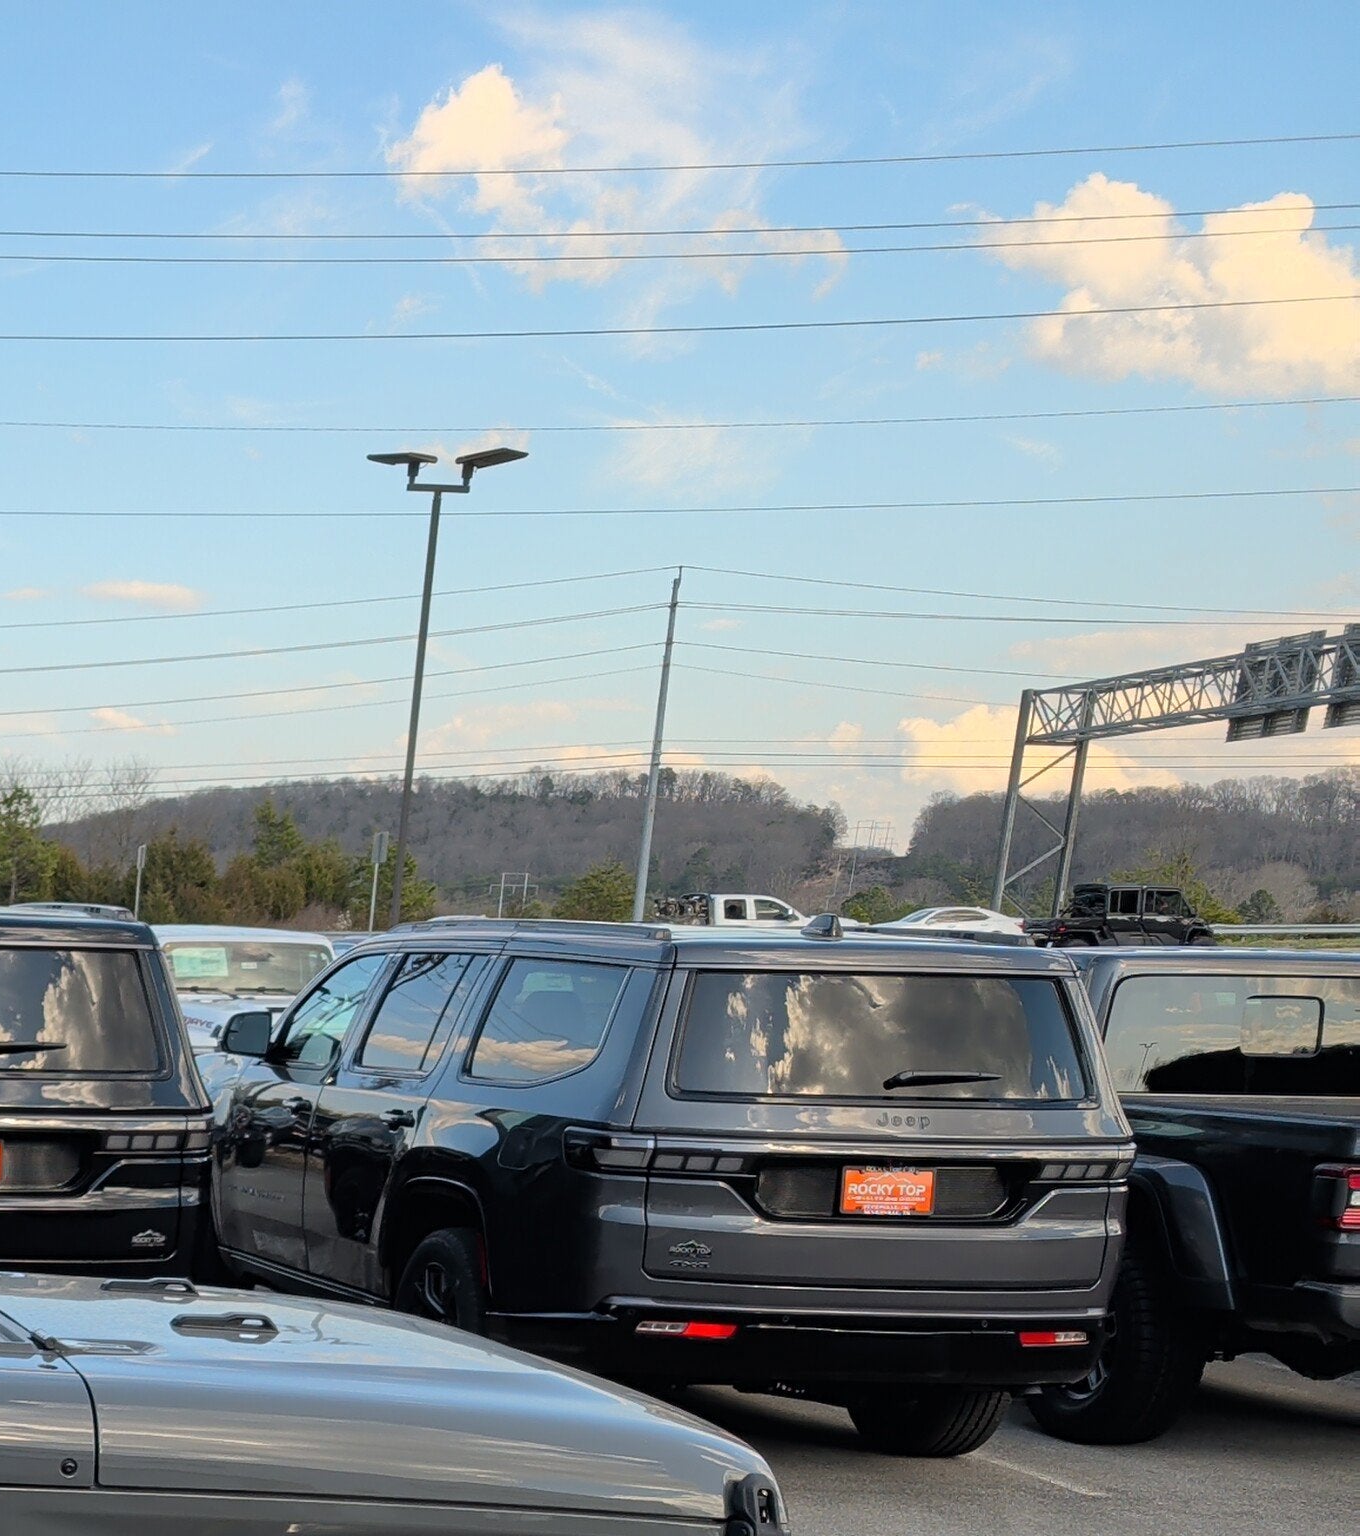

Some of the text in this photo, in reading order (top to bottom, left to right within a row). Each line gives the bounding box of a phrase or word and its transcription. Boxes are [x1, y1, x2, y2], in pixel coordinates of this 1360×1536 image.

[876, 1112, 931, 1130] Jeep
[848, 1183, 926, 1196] ROCKY TOP
